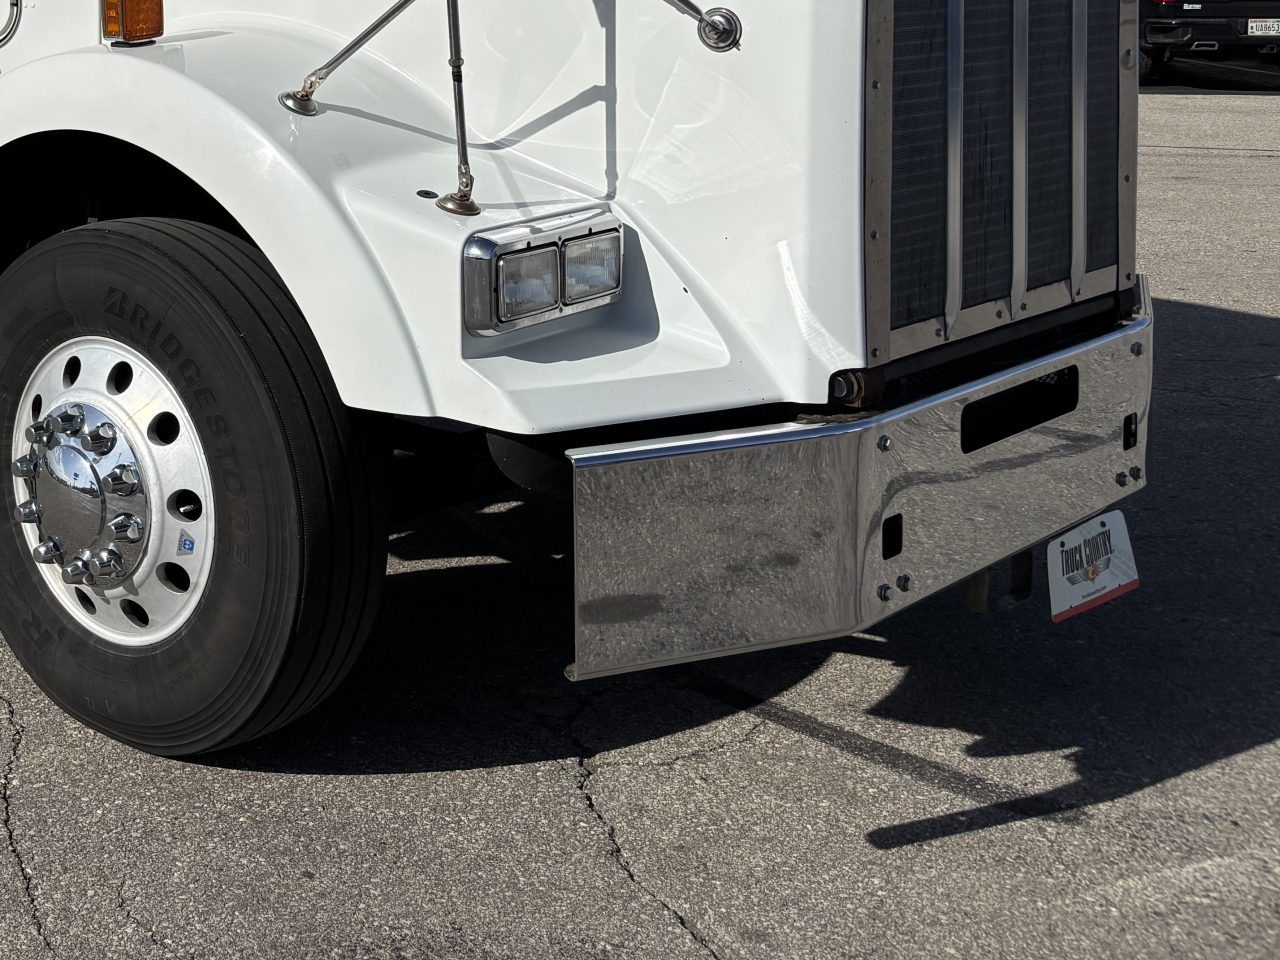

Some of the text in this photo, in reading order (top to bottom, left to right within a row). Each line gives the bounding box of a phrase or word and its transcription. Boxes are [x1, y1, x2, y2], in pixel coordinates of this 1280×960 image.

[104, 286, 250, 570] BRIDGESTONE
[1060, 529, 1112, 577] TRUCK COUNTRY
